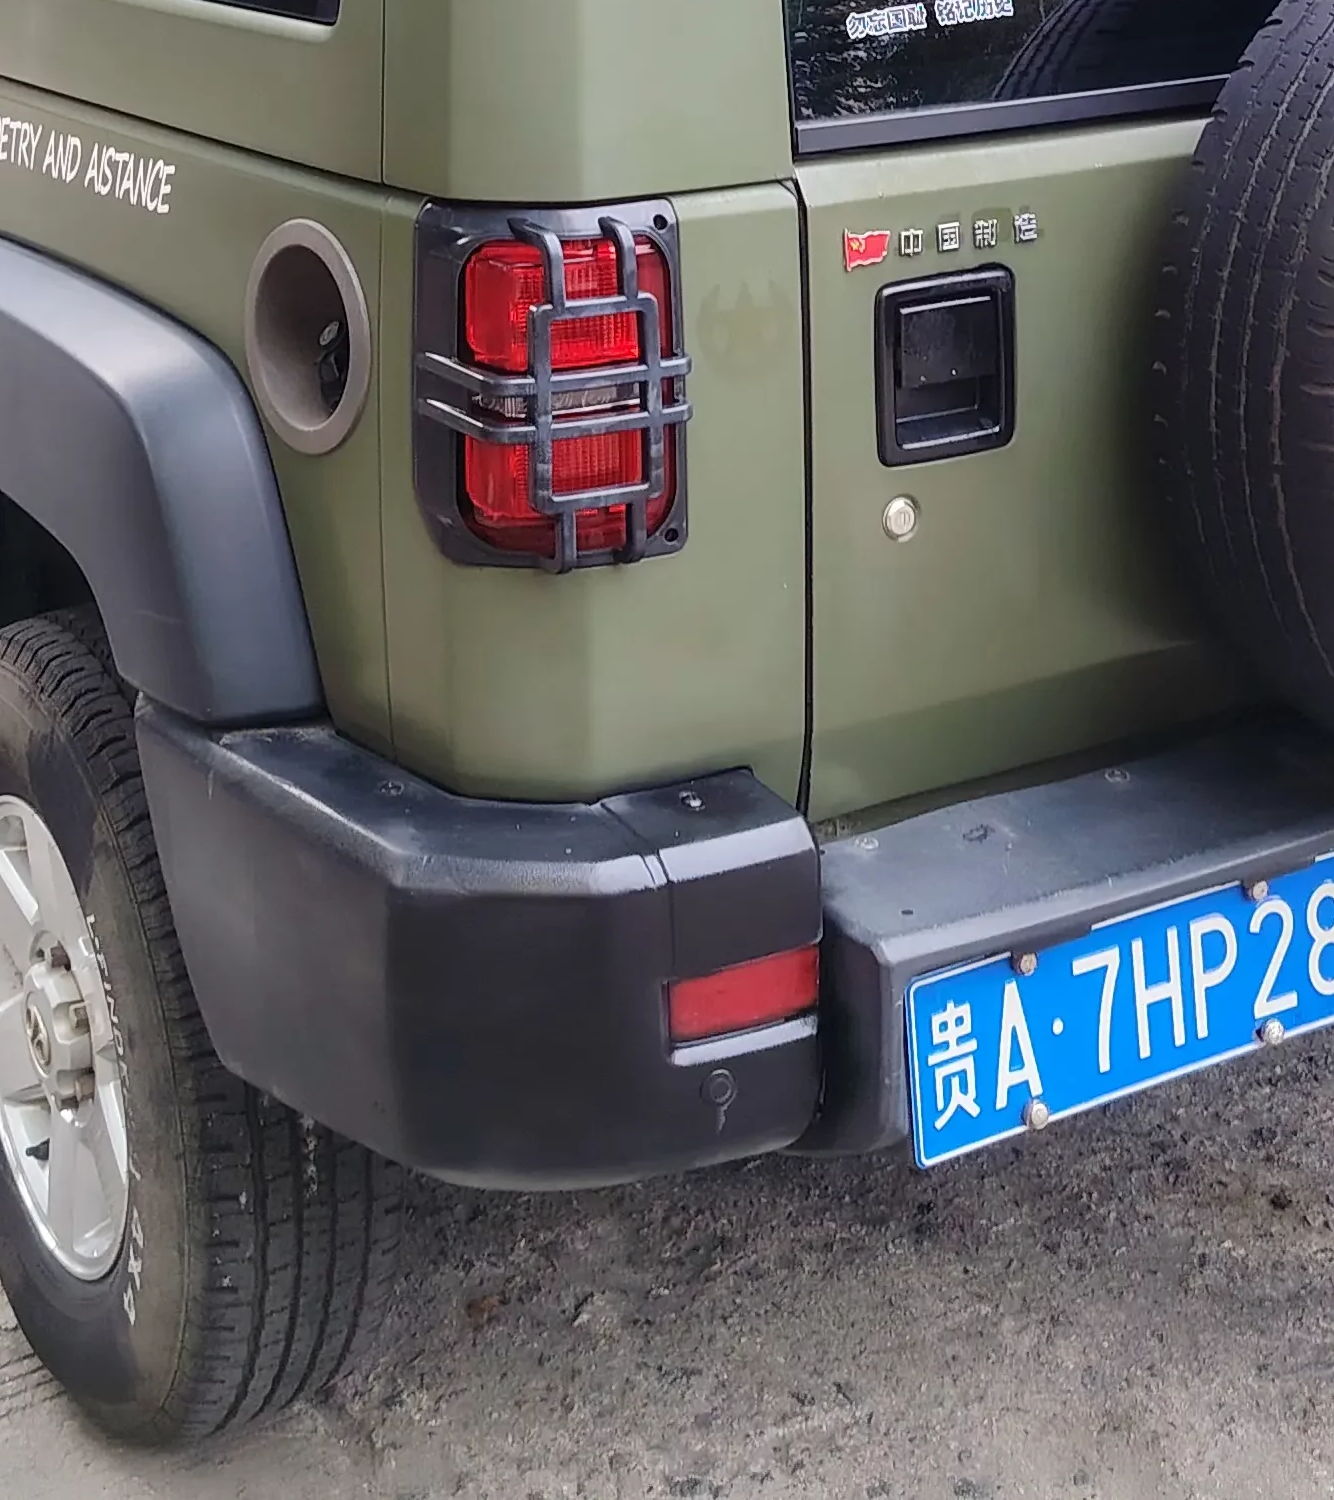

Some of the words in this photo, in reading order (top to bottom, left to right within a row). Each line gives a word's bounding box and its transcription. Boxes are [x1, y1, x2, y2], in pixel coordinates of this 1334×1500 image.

[847, 2, 927, 39] 勿忘国耻
[42, 129, 82, 184] AND
[83, 142, 176, 214] AISTANCE
[898, 212, 1038, 257] 中国制造
